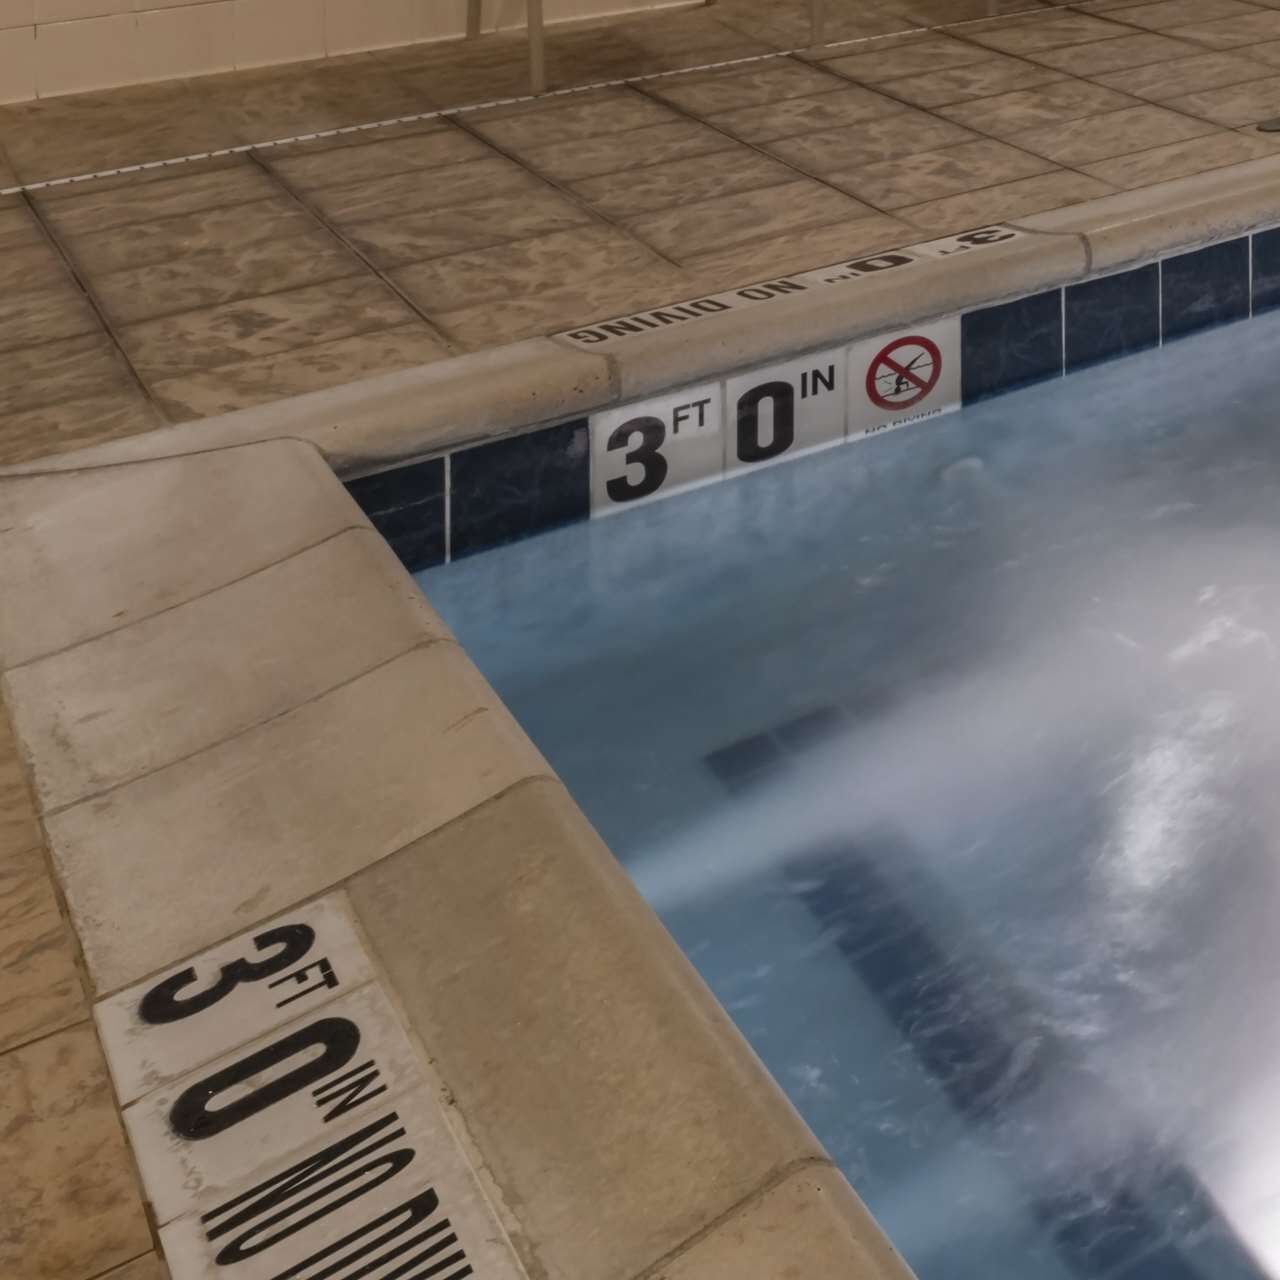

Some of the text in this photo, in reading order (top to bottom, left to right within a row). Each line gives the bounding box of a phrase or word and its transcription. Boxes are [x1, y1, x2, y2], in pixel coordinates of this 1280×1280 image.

[570, 229, 1016, 344] 3 FT 0 IN NO DIVING
[606, 415, 668, 503] 3
[672, 398, 711, 435] FT
[736, 380, 794, 463] 0
[801, 364, 835, 399] IN
[138, 923, 316, 1025] 3
[268, 957, 340, 1009] FT
[169, 1017, 361, 1141] 0
[312, 1059, 388, 1124] IN
[202, 1111, 415, 1266] NO
